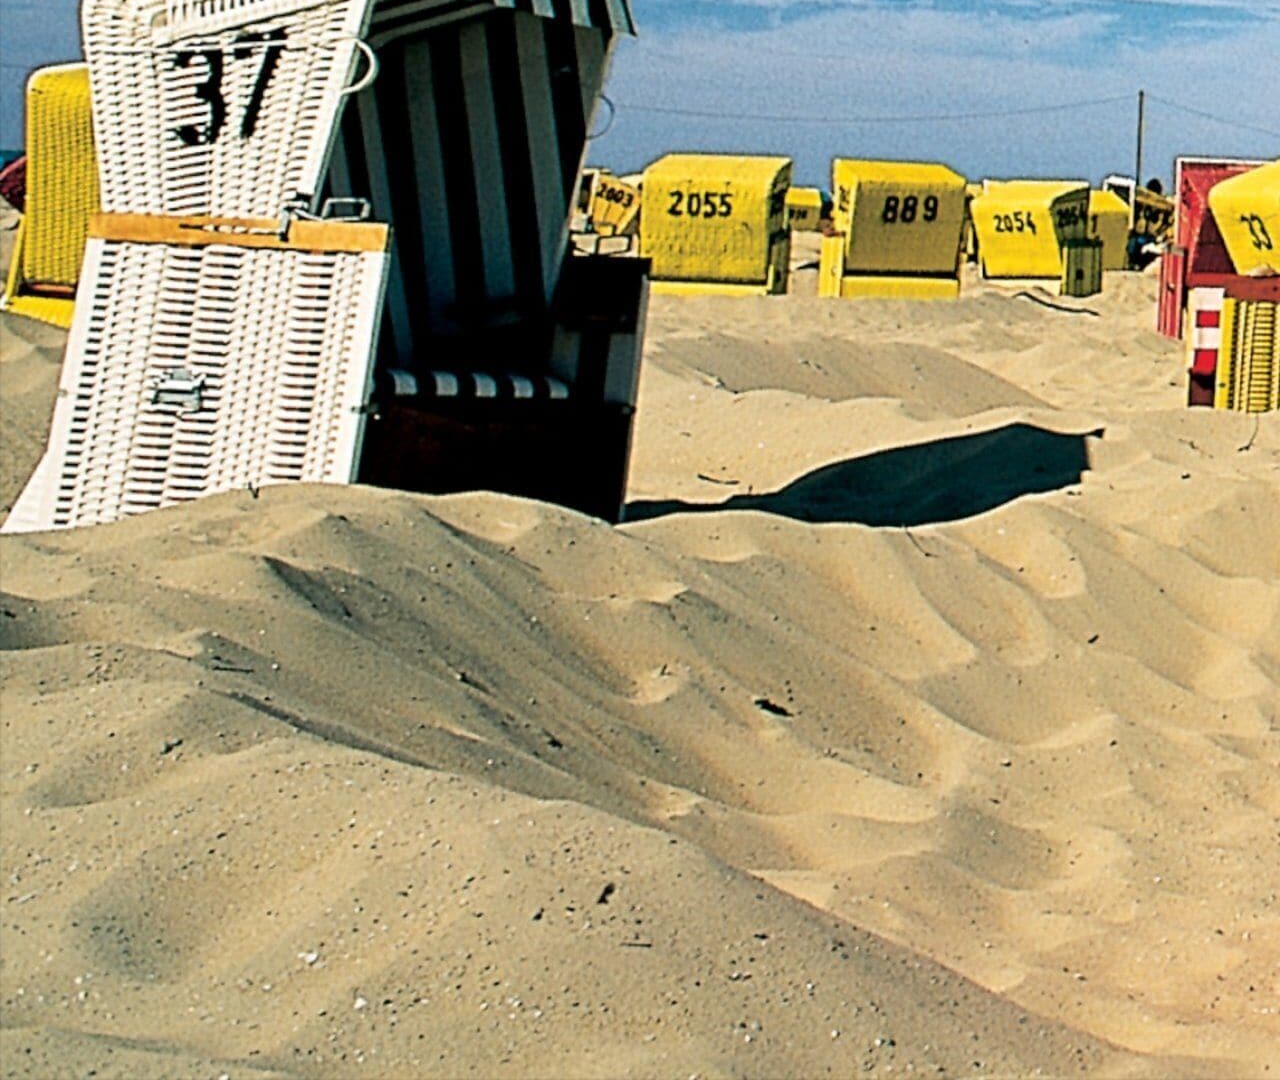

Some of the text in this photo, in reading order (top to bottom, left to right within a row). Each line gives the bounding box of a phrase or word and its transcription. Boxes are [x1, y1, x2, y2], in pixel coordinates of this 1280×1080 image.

[172, 26, 288, 146] 37
[595, 182, 634, 208] 2003
[667, 190, 733, 218] 2055
[881, 195, 938, 223] 889
[993, 210, 1037, 235] 2054
